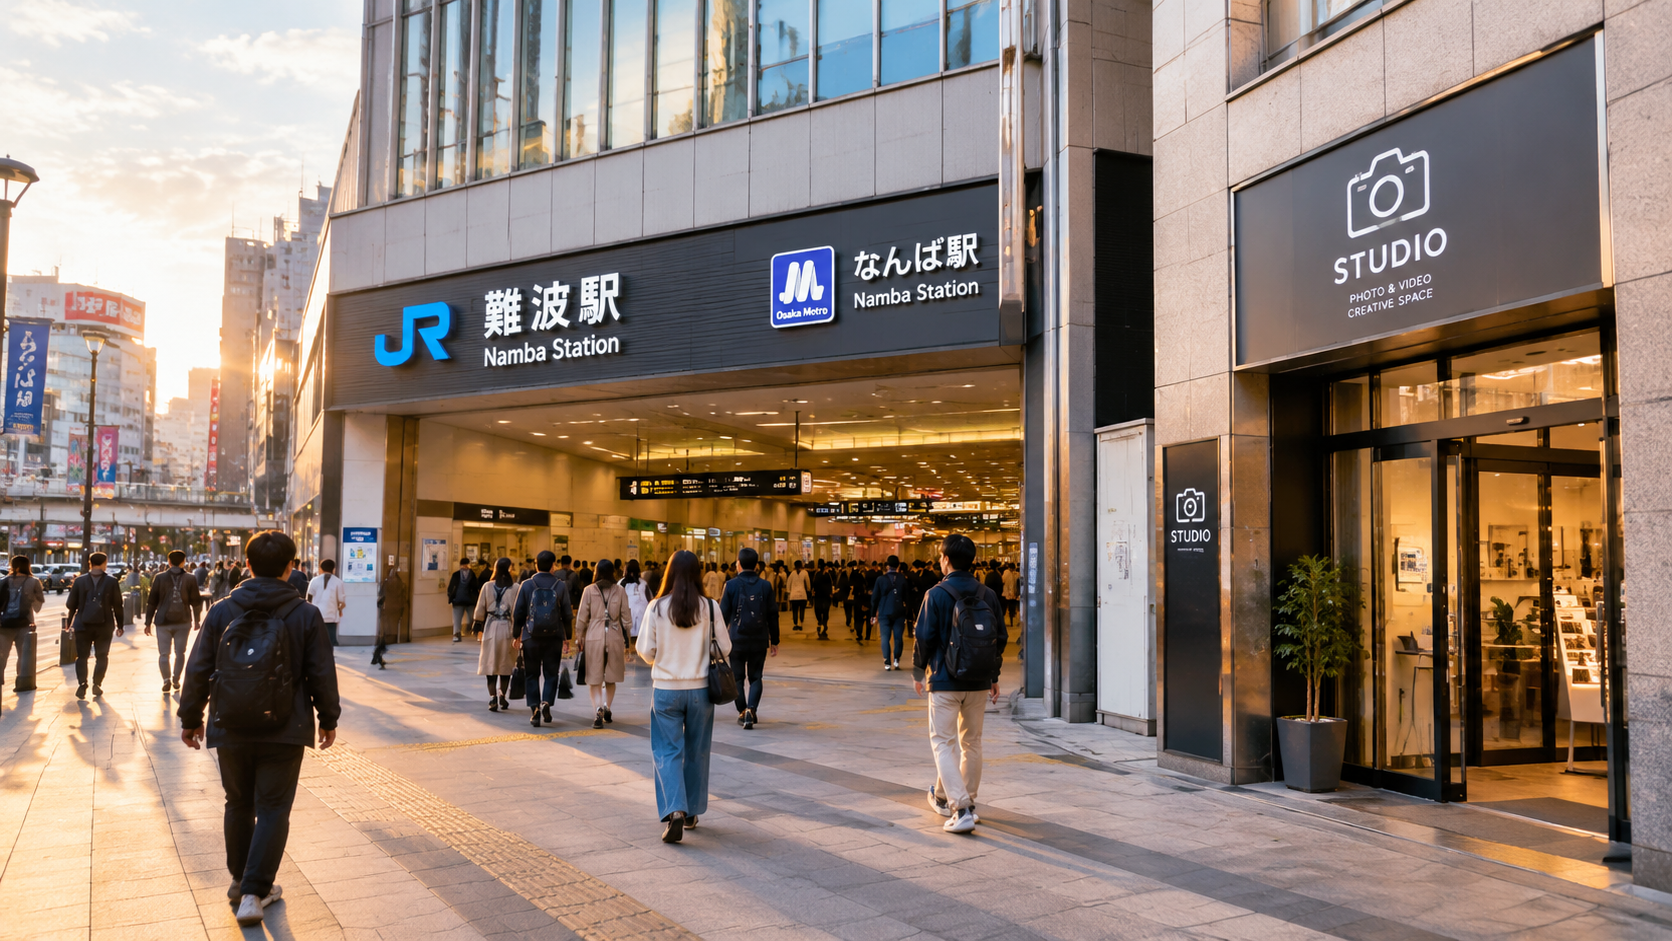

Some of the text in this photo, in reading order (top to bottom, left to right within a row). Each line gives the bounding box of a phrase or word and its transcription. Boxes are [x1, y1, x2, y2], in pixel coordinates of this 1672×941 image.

[854, 232, 979, 281] なんば駅
[1333, 227, 1448, 285] STUDIO
[853, 280, 979, 309] Namba Station
[1347, 287, 1434, 319] CREATIVE SPACE
[1349, 273, 1432, 304] PHOTO & VIDEO
[483, 272, 621, 339] 難波駅
[374, 301, 451, 367] JR
[483, 336, 619, 367] Namba Station
[1170, 528, 1211, 544] STUDIO
